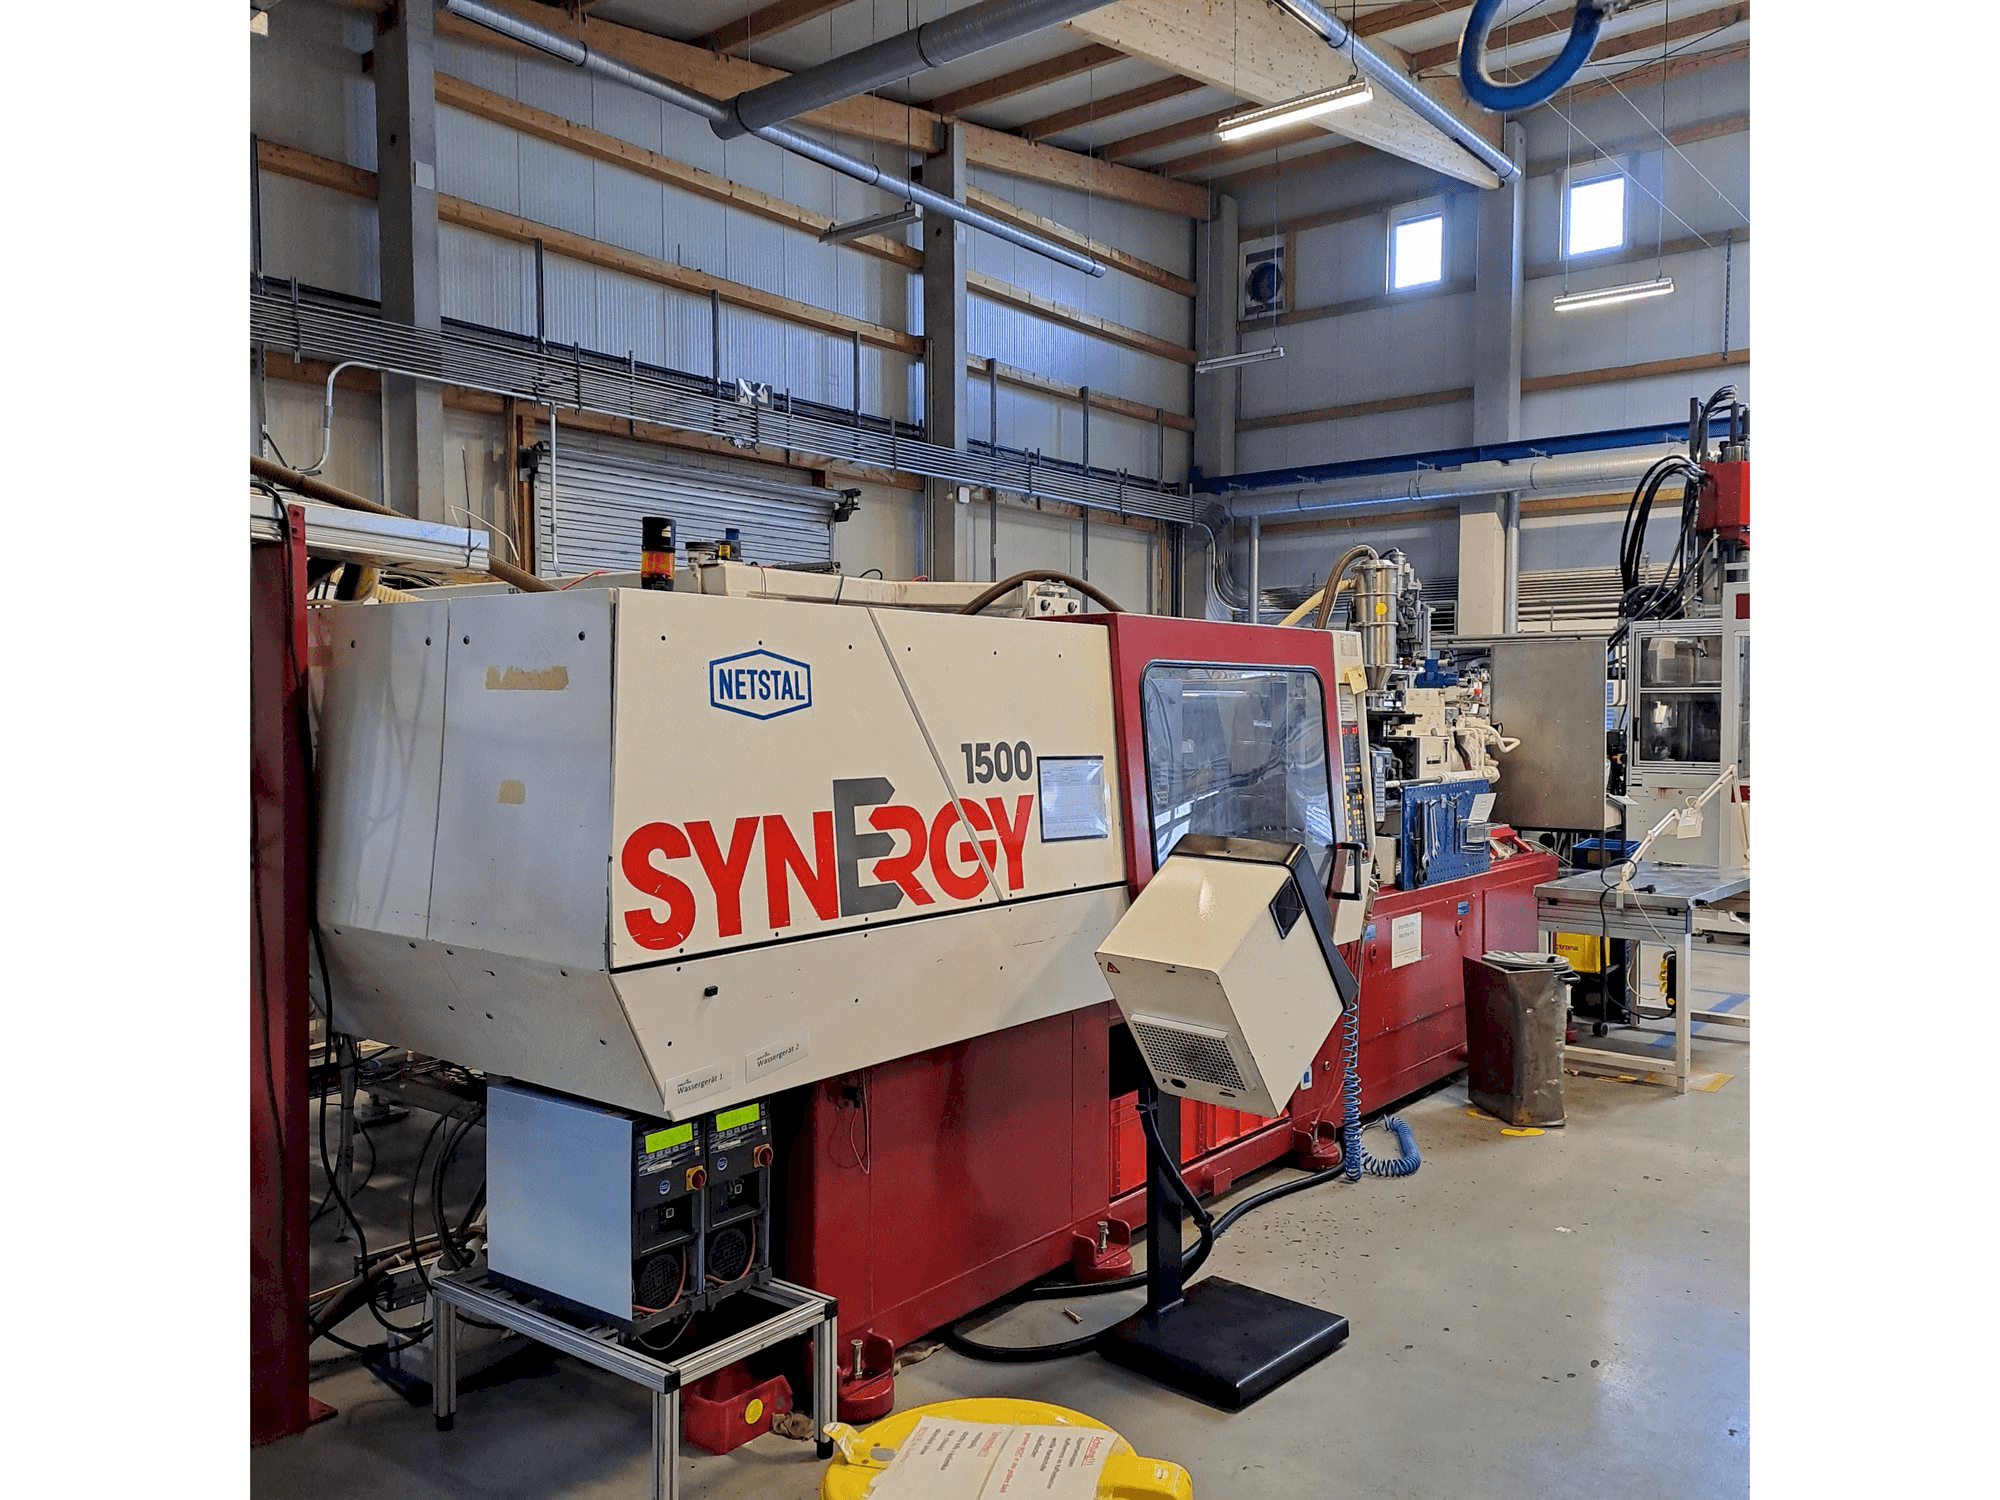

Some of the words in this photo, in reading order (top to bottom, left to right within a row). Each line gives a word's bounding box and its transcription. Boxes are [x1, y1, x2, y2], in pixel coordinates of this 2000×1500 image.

[718, 669, 807, 702] NETSTAL
[960, 741, 1033, 784] 1500
[621, 776, 1034, 951] SYNERGY
[756, 1046, 794, 1067] Wassergerät
[676, 1075, 718, 1095] Wassergerät
